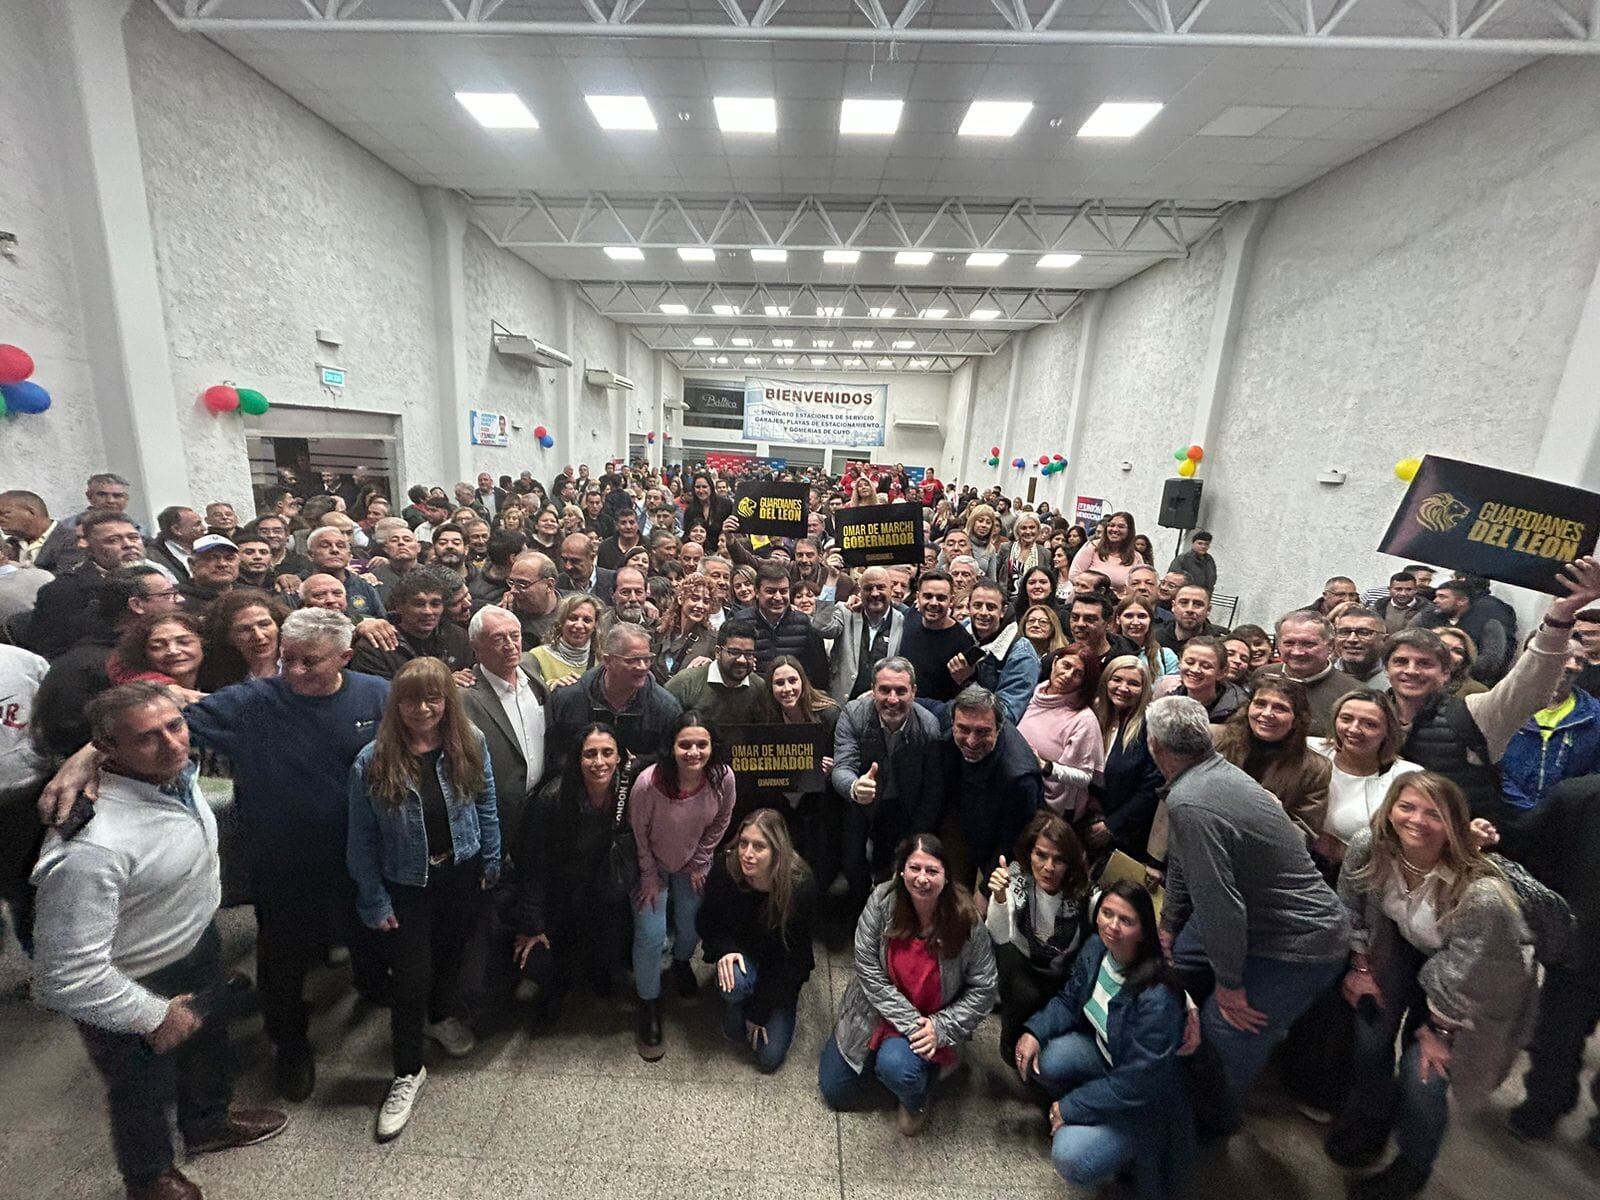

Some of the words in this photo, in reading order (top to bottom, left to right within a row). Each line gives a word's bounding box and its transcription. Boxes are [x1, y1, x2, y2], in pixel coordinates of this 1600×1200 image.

[765, 388, 873, 405] BIENVENIDOS
[761, 409, 794, 418] SINDICATO
[795, 412, 834, 420] ESTACIONES
[755, 417, 786, 425] GARAJES,
[821, 421, 880, 429] ESTACIONAMIENTO
[760, 496, 803, 510] GUARDIANES
[759, 508, 776, 520] DEL
[1478, 501, 1585, 541] GUARDIANES
[843, 524, 866, 537] OMAR
[868, 523, 879, 535] DE
[881, 520, 914, 534] MARCHI
[1467, 519, 1513, 549] DEL
[843, 532, 915, 549] GOBERNADOR
[732, 744, 759, 757] OMAR
[761, 744, 774, 757] DE
[776, 743, 813, 756] MARCHI
[732, 756, 814, 772] GOBERNADOR
